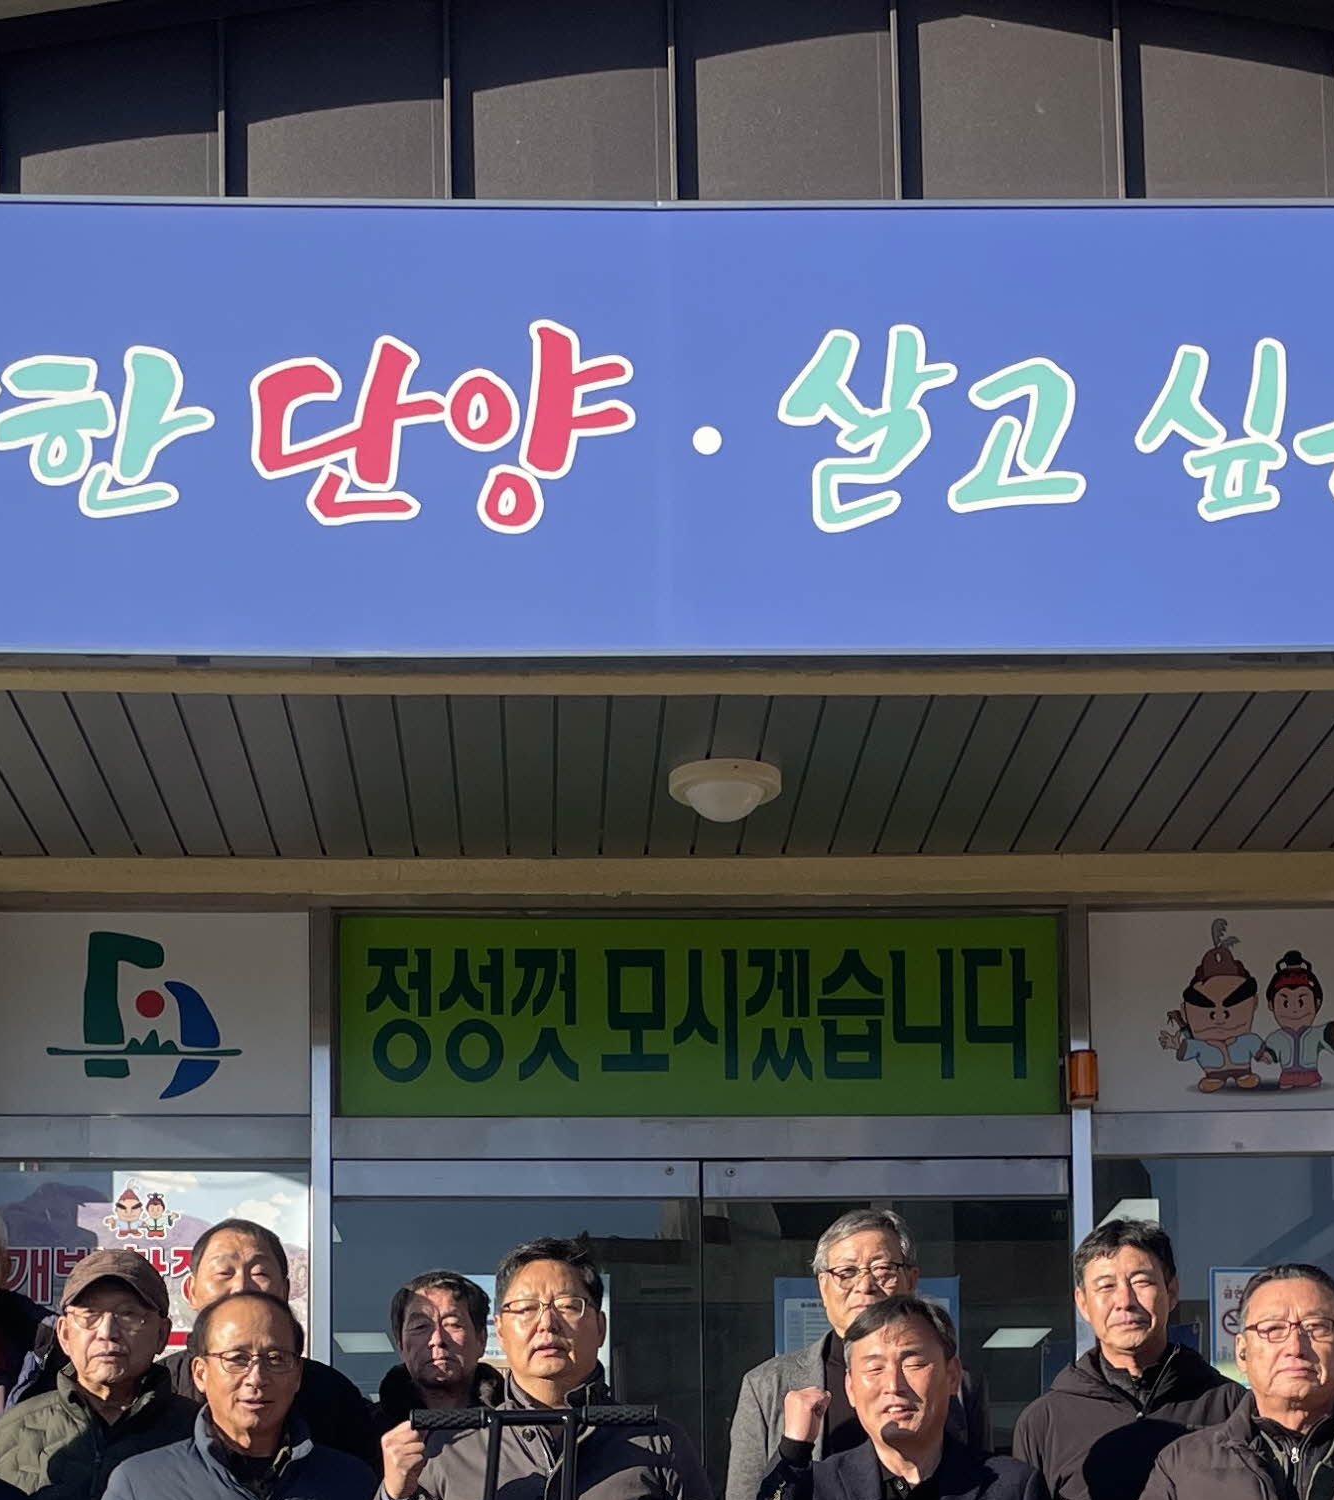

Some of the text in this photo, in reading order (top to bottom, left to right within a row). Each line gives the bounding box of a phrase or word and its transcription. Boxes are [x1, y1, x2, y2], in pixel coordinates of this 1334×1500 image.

[249, 318, 636, 534] 단양
[778, 324, 1087, 533] 살고
[366, 946, 1034, 1083] 정성껏 모시겠습니다
